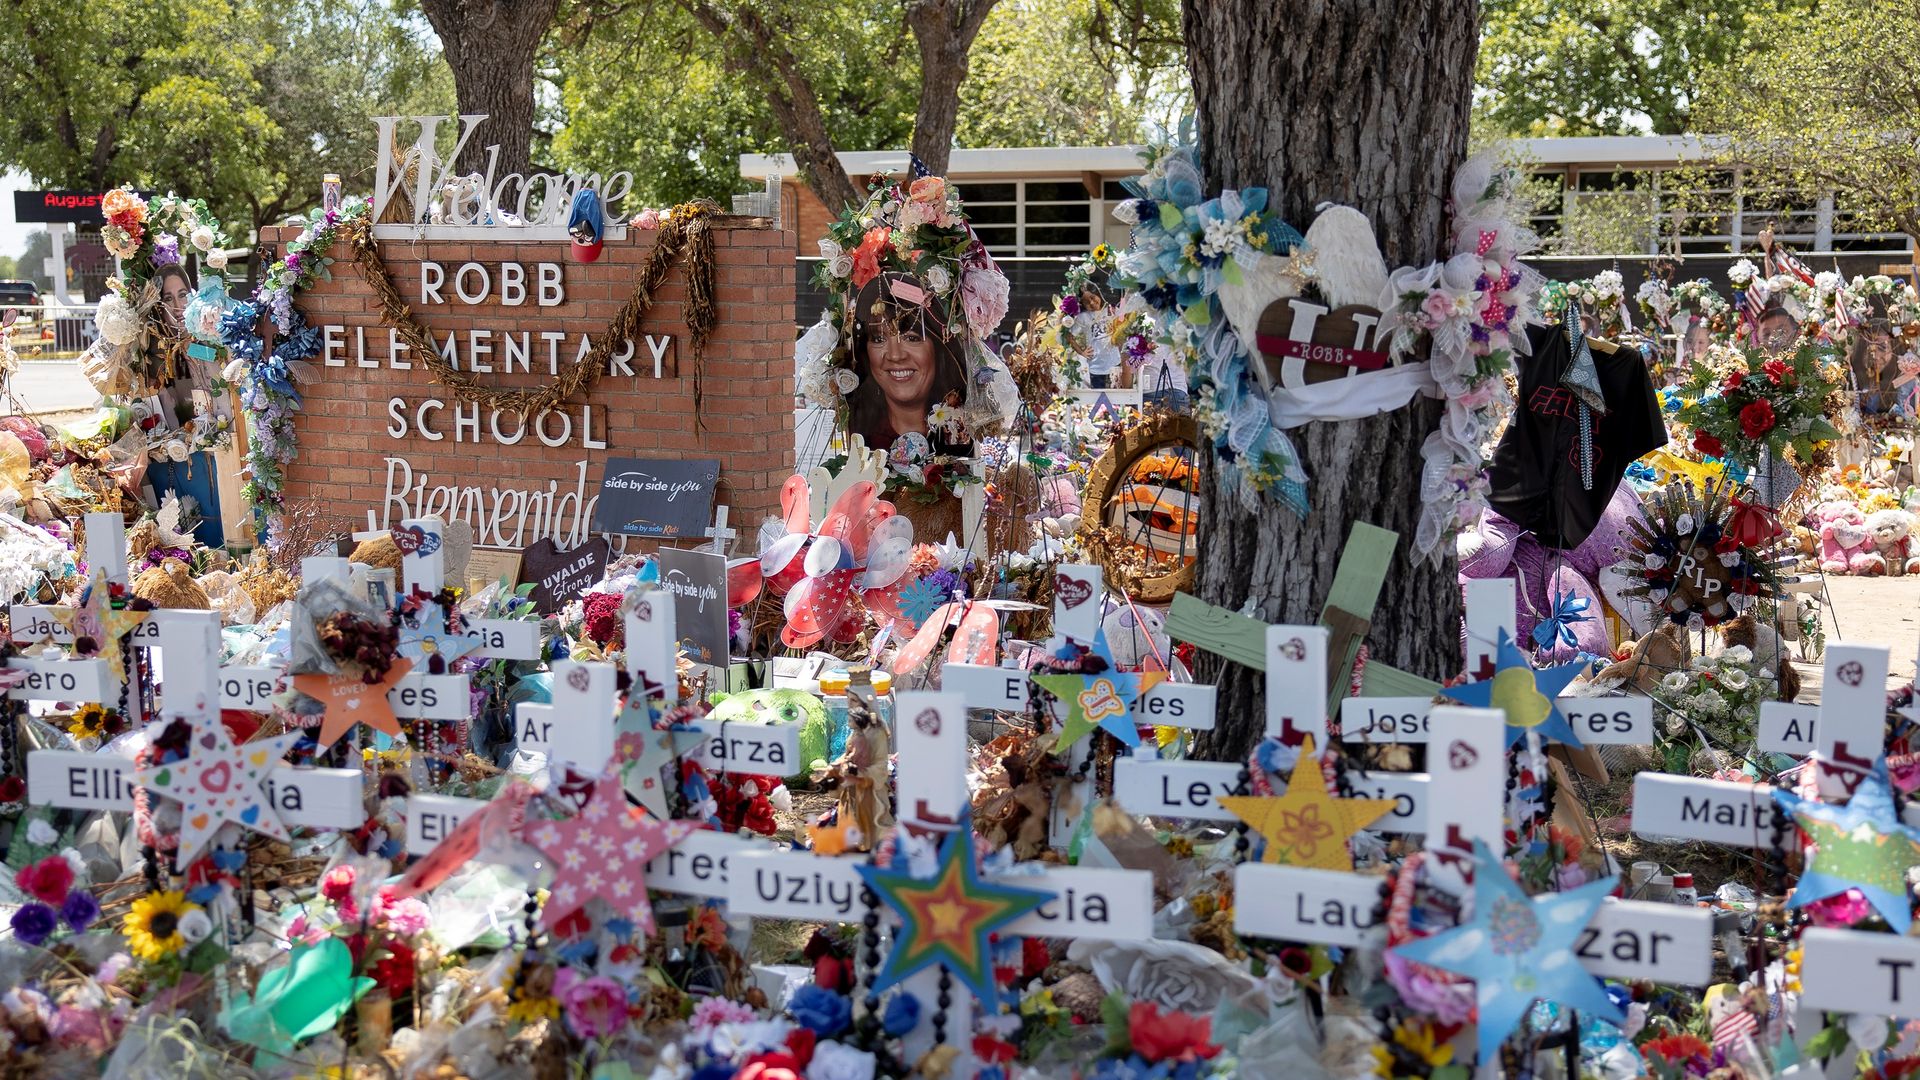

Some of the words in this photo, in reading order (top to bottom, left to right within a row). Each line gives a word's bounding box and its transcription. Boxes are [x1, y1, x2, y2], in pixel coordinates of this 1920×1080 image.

[371, 114, 634, 226] Welcome
[44, 193, 104, 208] August
[421, 261, 566, 306] ROBB
[324, 325, 671, 379] ELEMENTARY
[1300, 343, 1344, 363] ROBB
[388, 397, 607, 450] SCHOOL
[605, 477, 628, 488] side
[629, 479, 644, 492] by
[645, 477, 668, 491] side
[667, 480, 702, 502] you
[543, 552, 595, 589] UVALDE
[1674, 552, 1721, 598] RIP
[553, 574, 593, 602] Strong
[675, 581, 684, 597] by
[684, 577, 698, 597] side
[218, 679, 272, 706] oje
